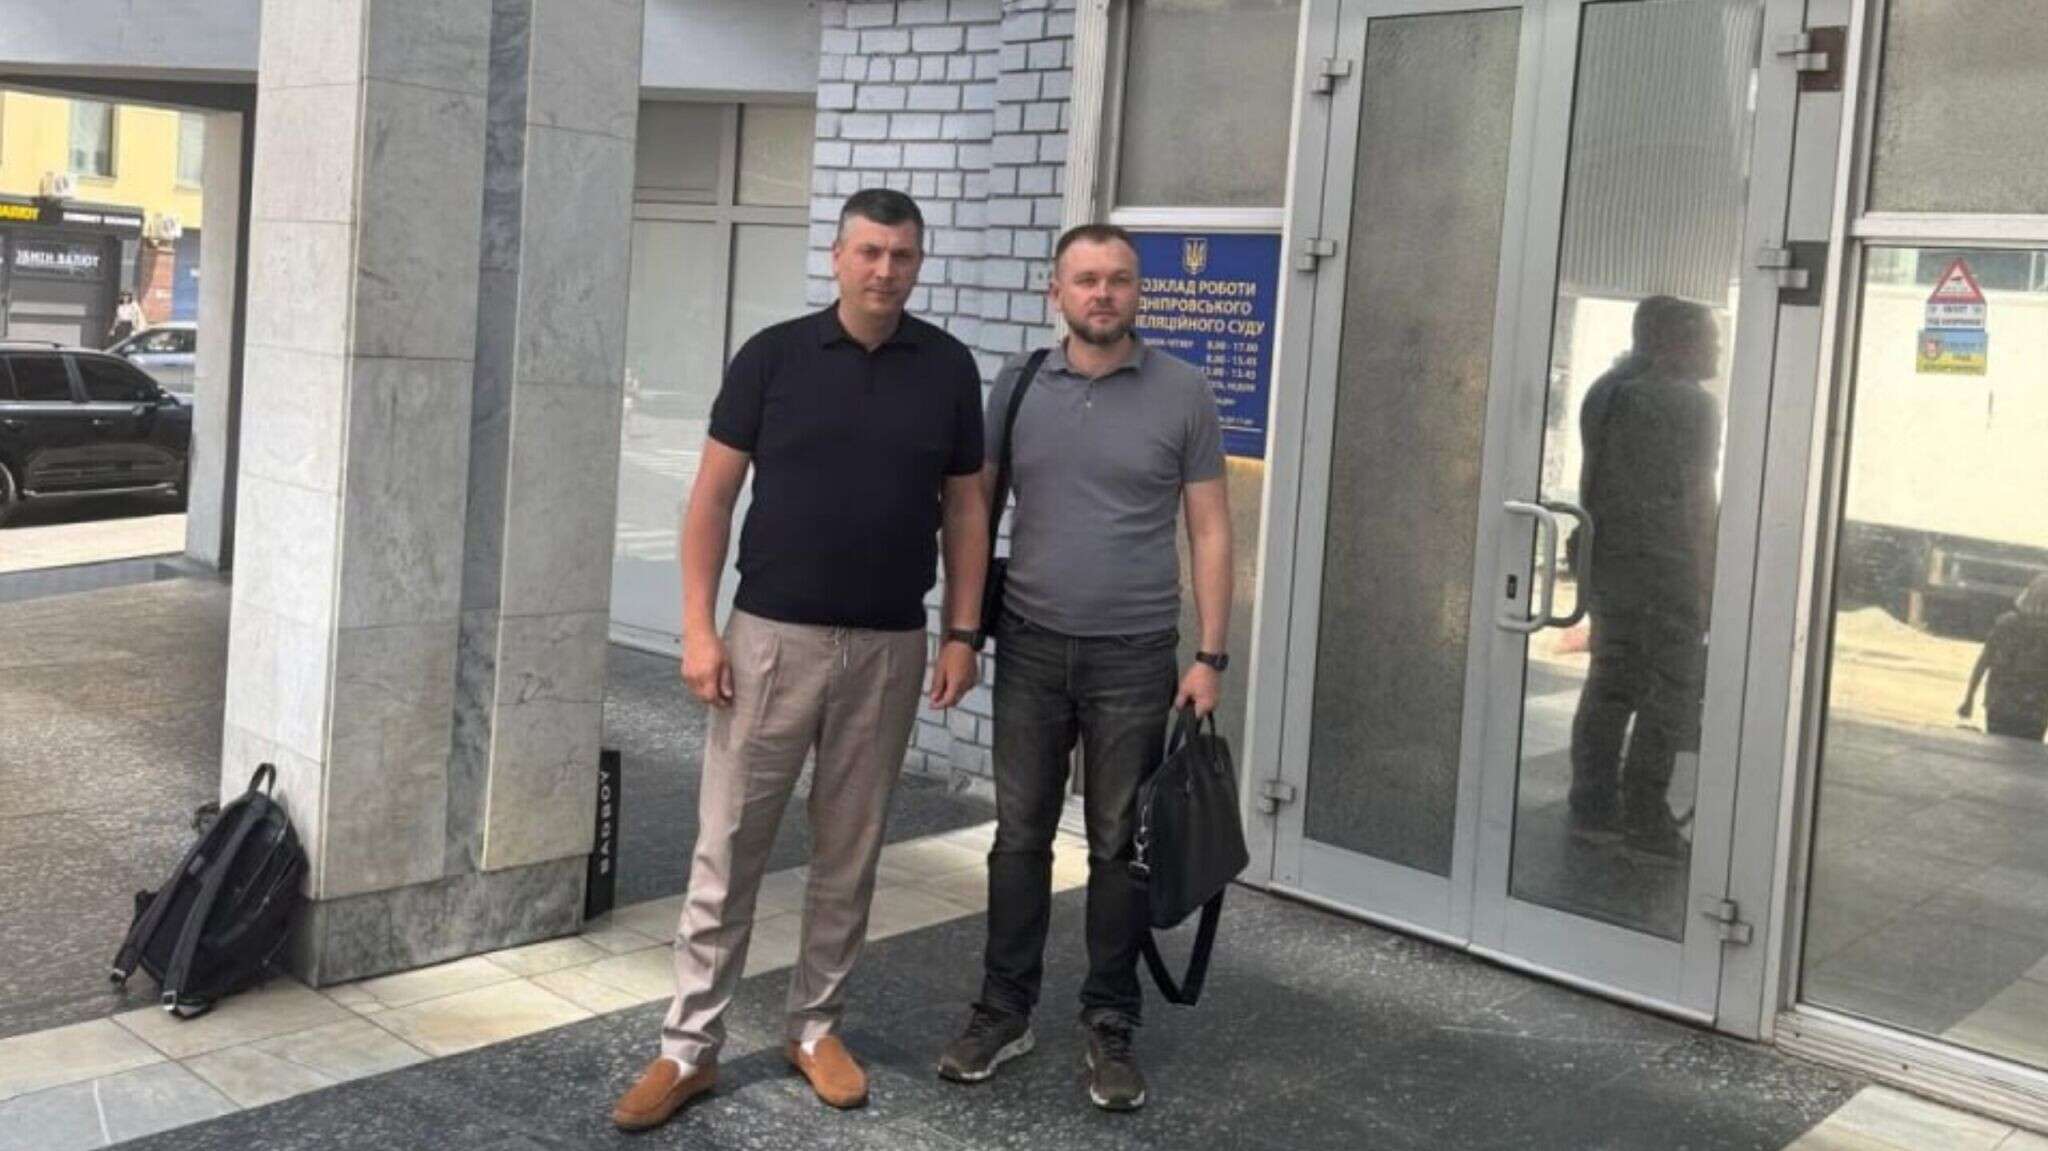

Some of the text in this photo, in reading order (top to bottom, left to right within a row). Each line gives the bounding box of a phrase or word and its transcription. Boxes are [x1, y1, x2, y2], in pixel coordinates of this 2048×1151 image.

[1142, 278, 1256, 296] ОЗКЛАД РОБОТИ
[1138, 297, 1252, 315] ДНІПРОВСЬКОГО
[1135, 314, 1264, 336] ПЕЛЯЦІЙНОГО СУДУ
